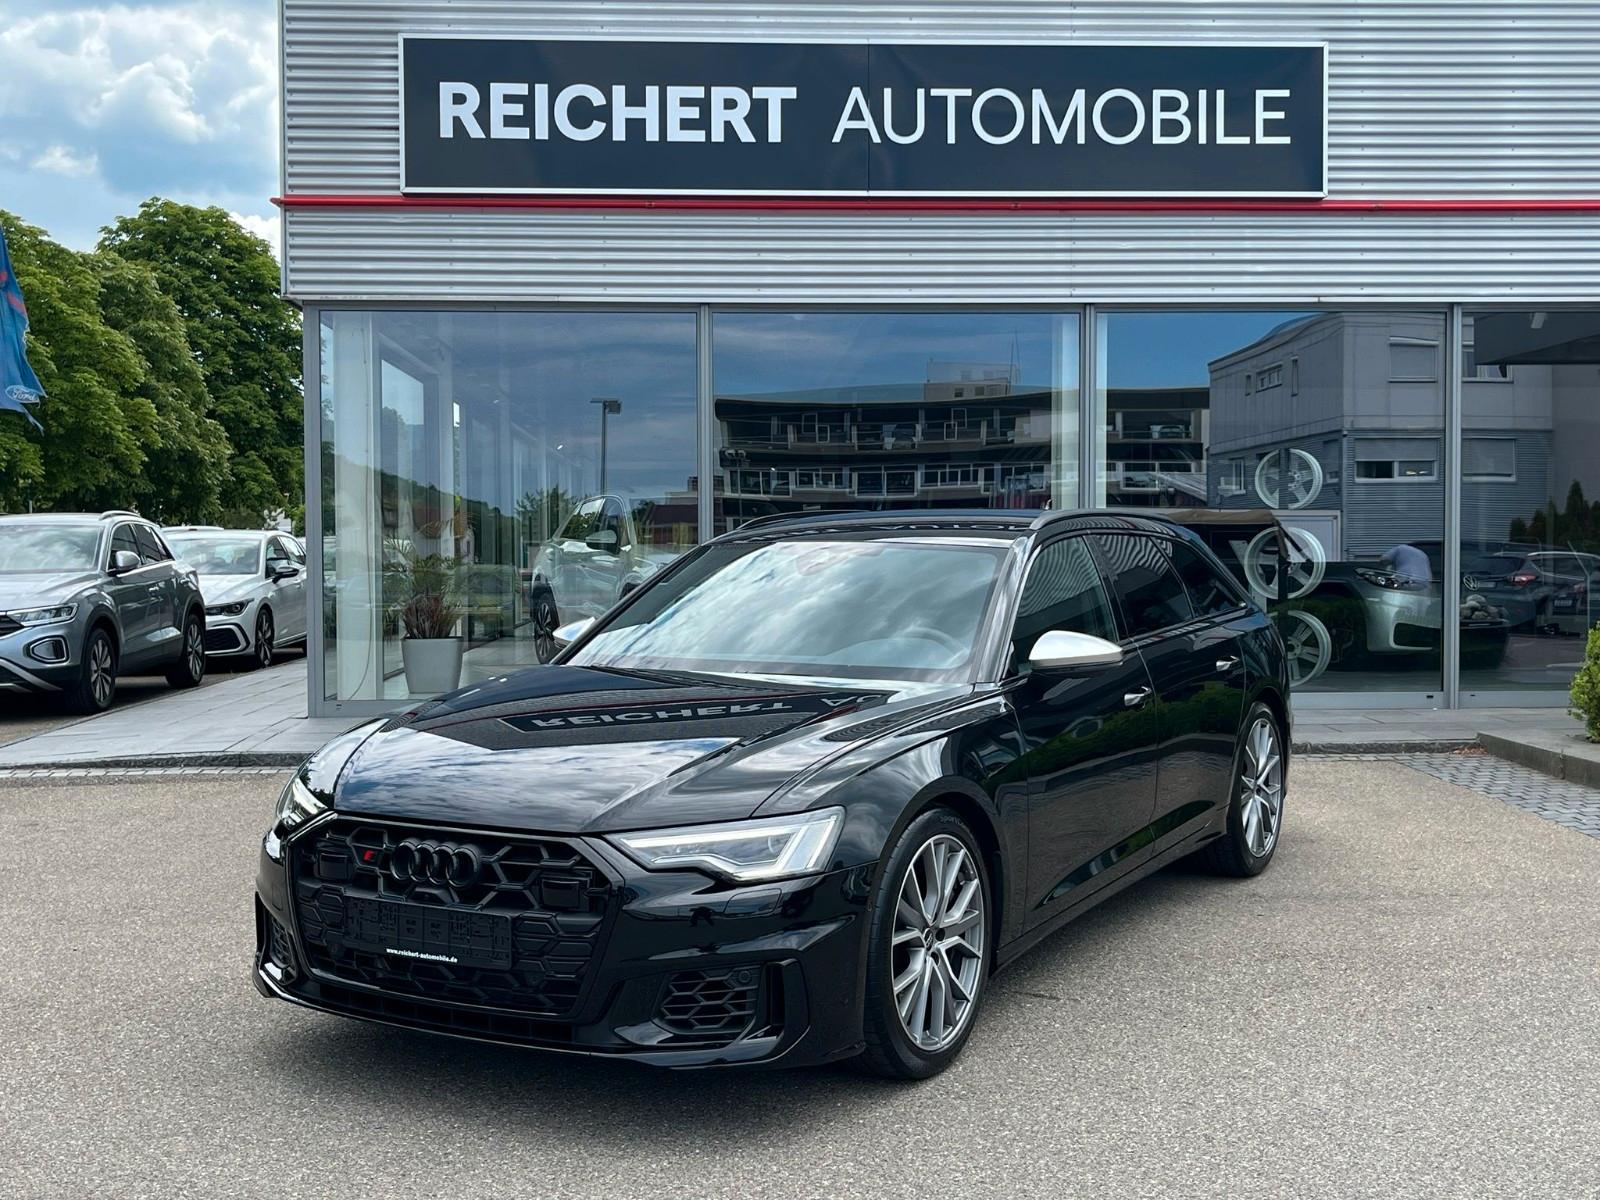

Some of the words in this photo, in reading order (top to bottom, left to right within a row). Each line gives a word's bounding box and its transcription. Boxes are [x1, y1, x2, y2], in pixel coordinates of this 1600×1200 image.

[439, 81, 797, 144] REICHERT
[831, 86, 1292, 146] AUTOMOBILE
[11, 387, 37, 402] Ford
[386, 948, 458, 963] www.reichert-automobile.de
